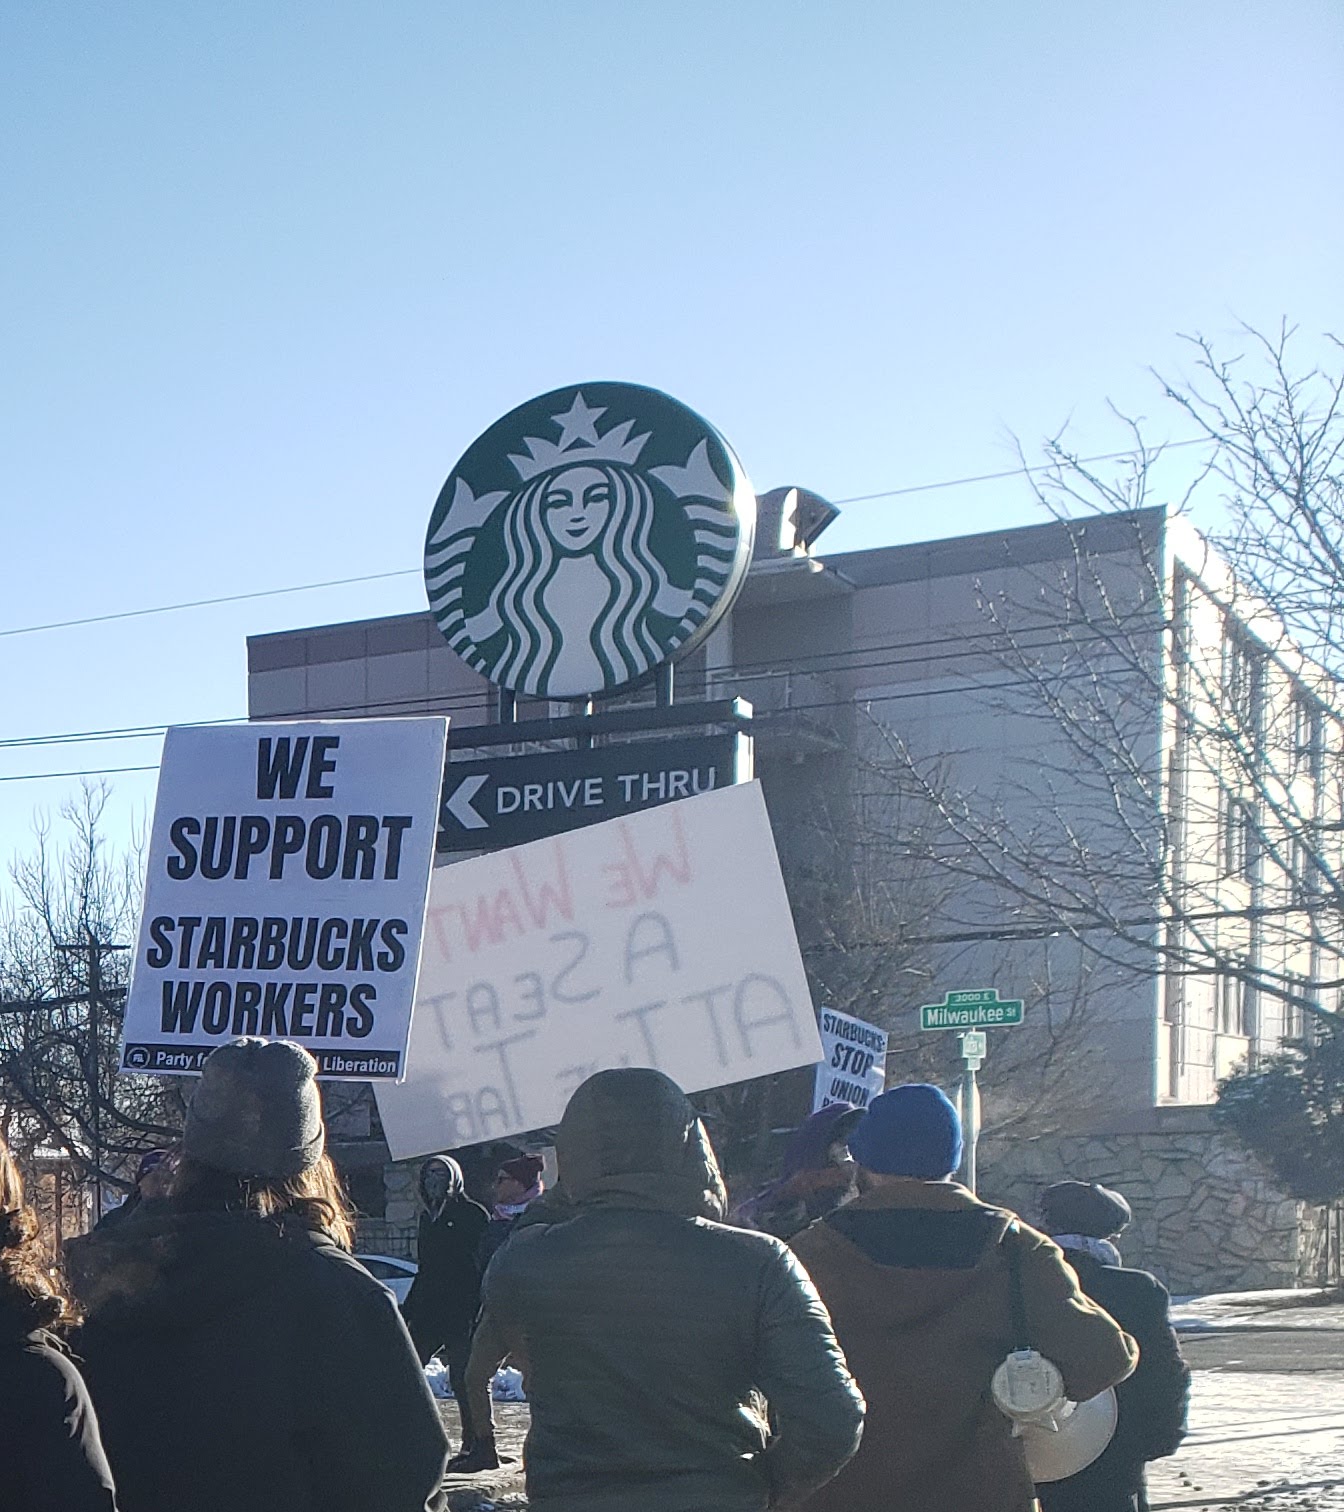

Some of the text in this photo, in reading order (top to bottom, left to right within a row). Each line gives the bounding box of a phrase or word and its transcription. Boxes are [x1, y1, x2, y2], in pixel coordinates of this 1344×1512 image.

[257, 736, 340, 800] WE
[496, 767, 716, 814] DRIVE THRU
[166, 814, 413, 881] SUPPORT
[146, 915, 409, 973] STARBUCKS
[161, 980, 377, 1039] WORKERS
[927, 1006, 1004, 1026] Milwaukee
[156, 1051, 195, 1070] Party
[323, 1056, 397, 1074] Liberation
[831, 1042, 874, 1079] STOP
[830, 1078, 870, 1108] UNION
